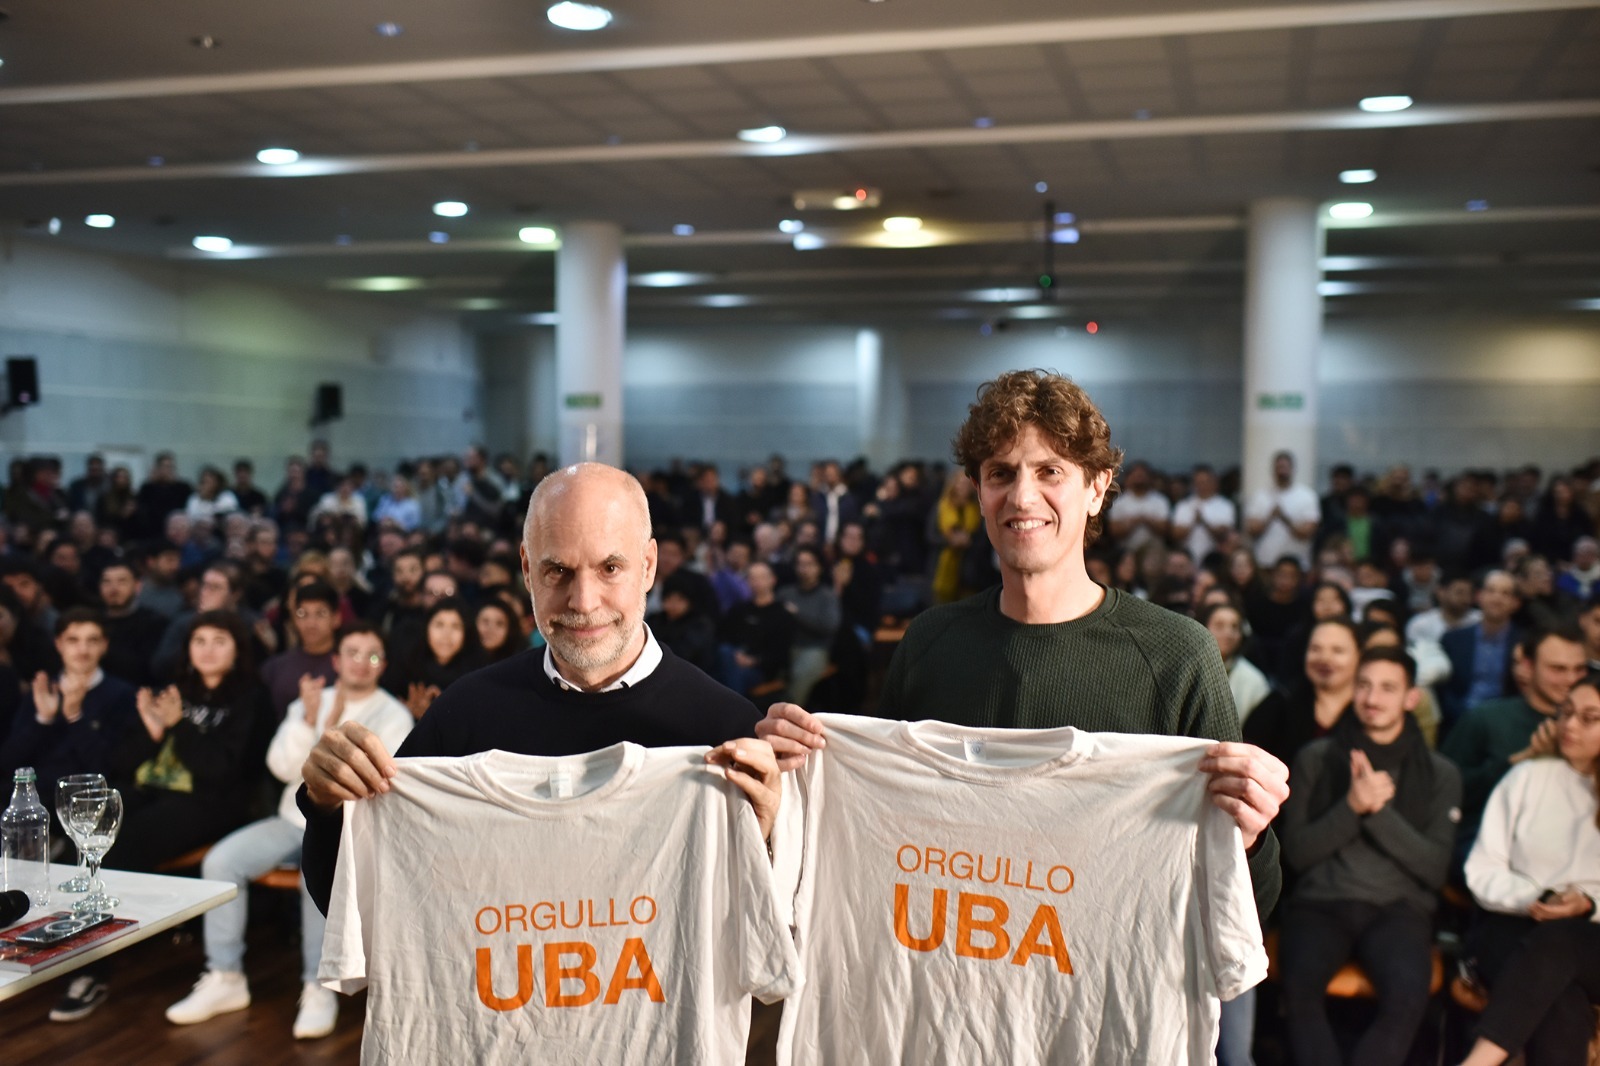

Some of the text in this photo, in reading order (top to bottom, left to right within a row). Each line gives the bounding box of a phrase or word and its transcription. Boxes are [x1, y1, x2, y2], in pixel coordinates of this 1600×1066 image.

[896, 844, 1075, 894] ORGULLO
[475, 895, 657, 935] ORGULLO
[893, 883, 1074, 975] UBA
[475, 937, 666, 1012] UBA
